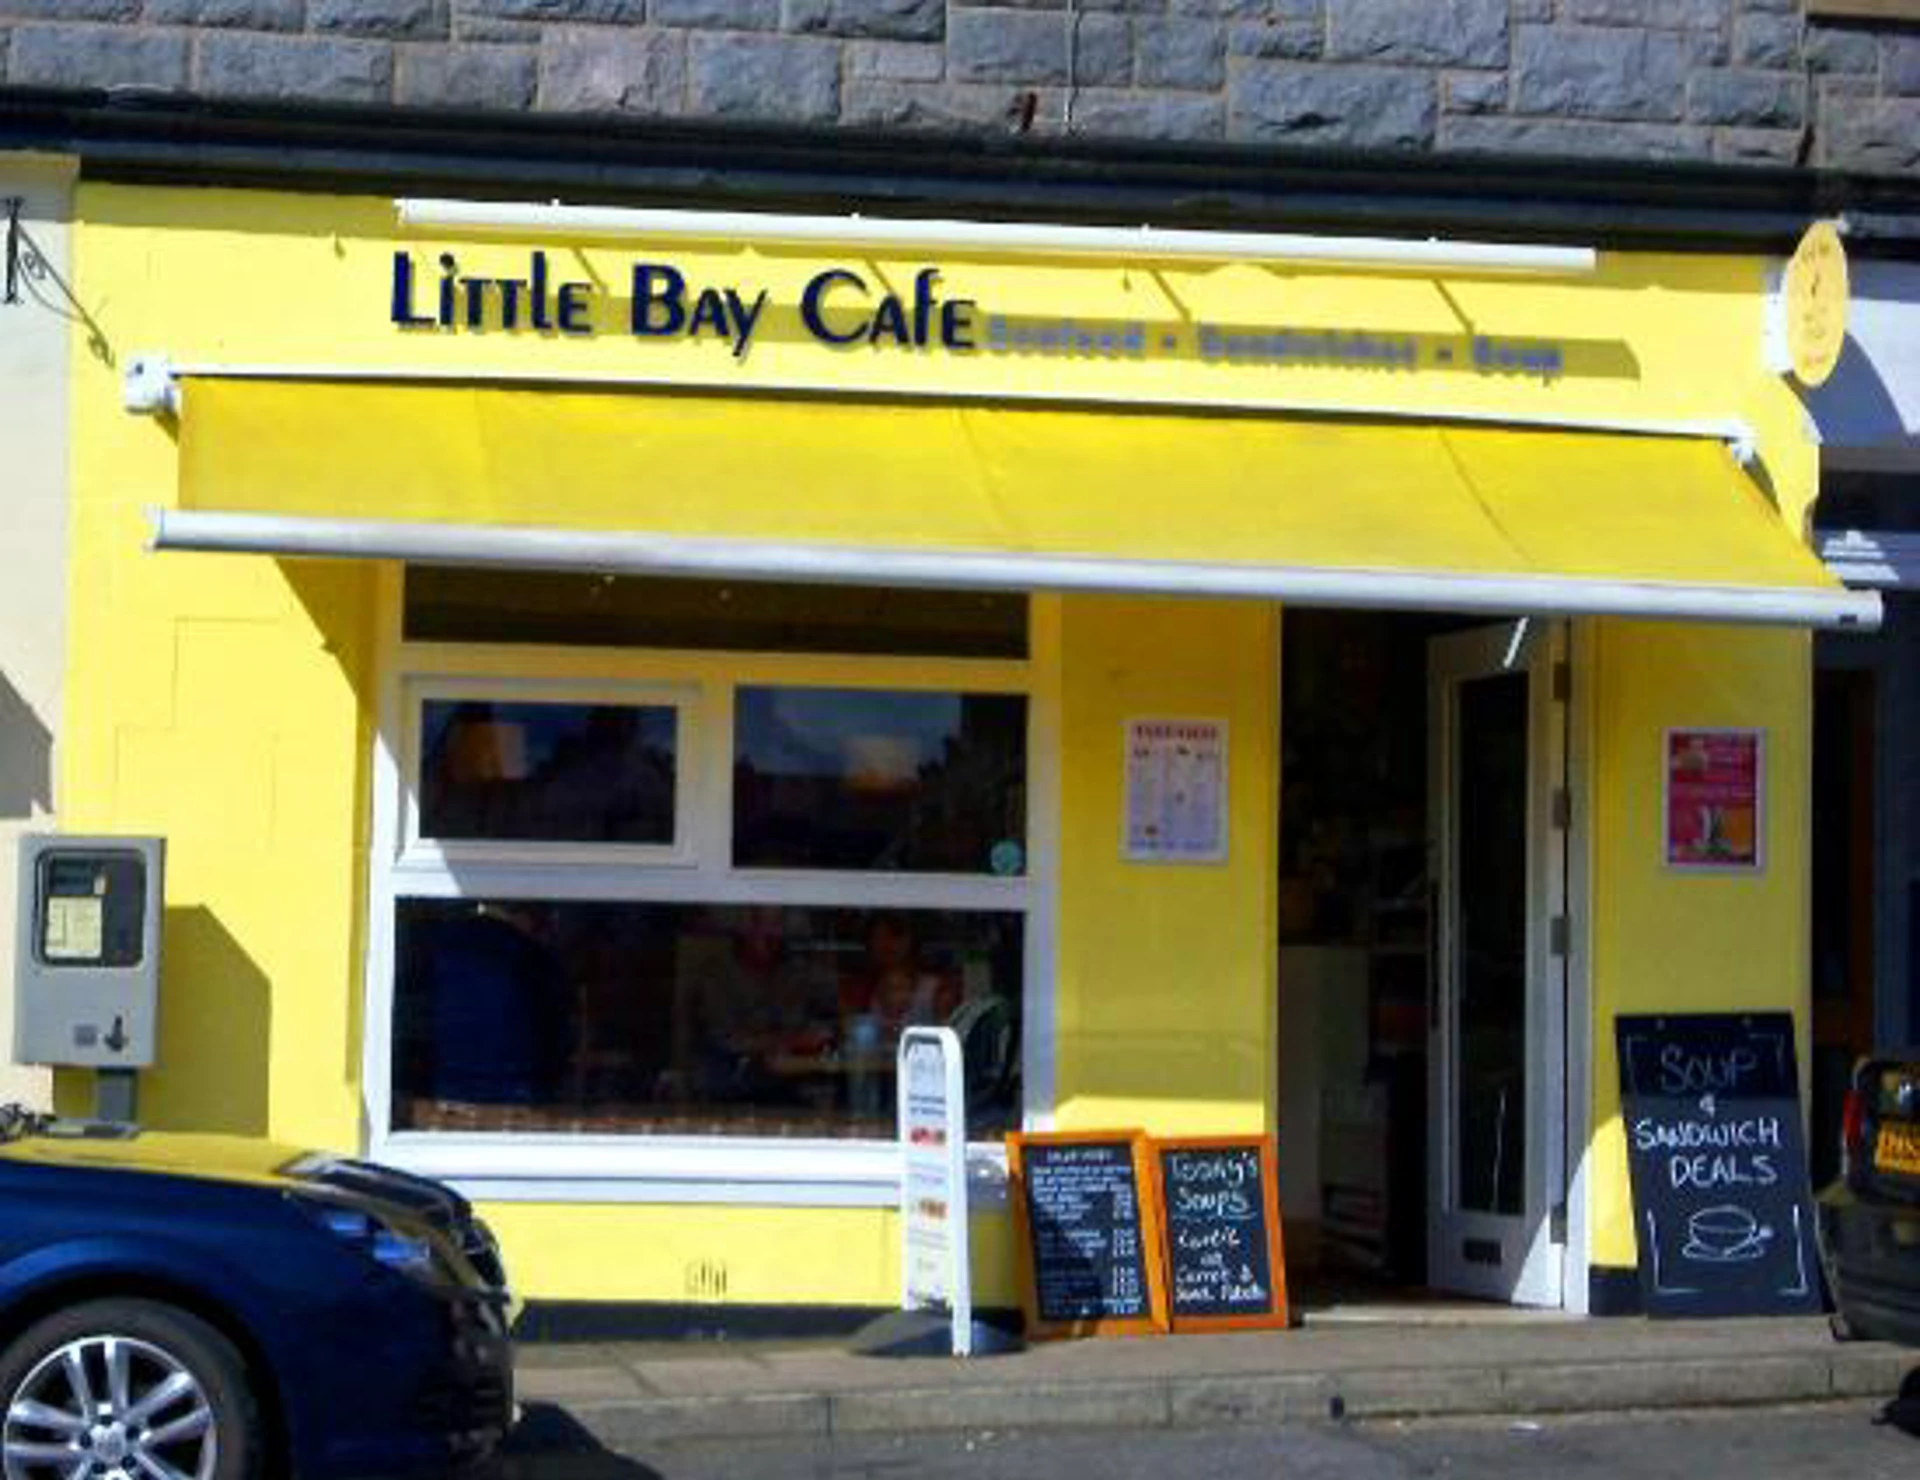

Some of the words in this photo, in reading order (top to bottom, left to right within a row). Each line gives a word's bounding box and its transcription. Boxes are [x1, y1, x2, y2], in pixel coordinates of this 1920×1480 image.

[631, 263, 766, 357] Bay
[800, 267, 976, 347] Cafe
[1660, 1043, 1756, 1093] SOUP
[1635, 1116, 1781, 1150] SANDWICH
[1670, 1153, 1778, 1189] DEALS
